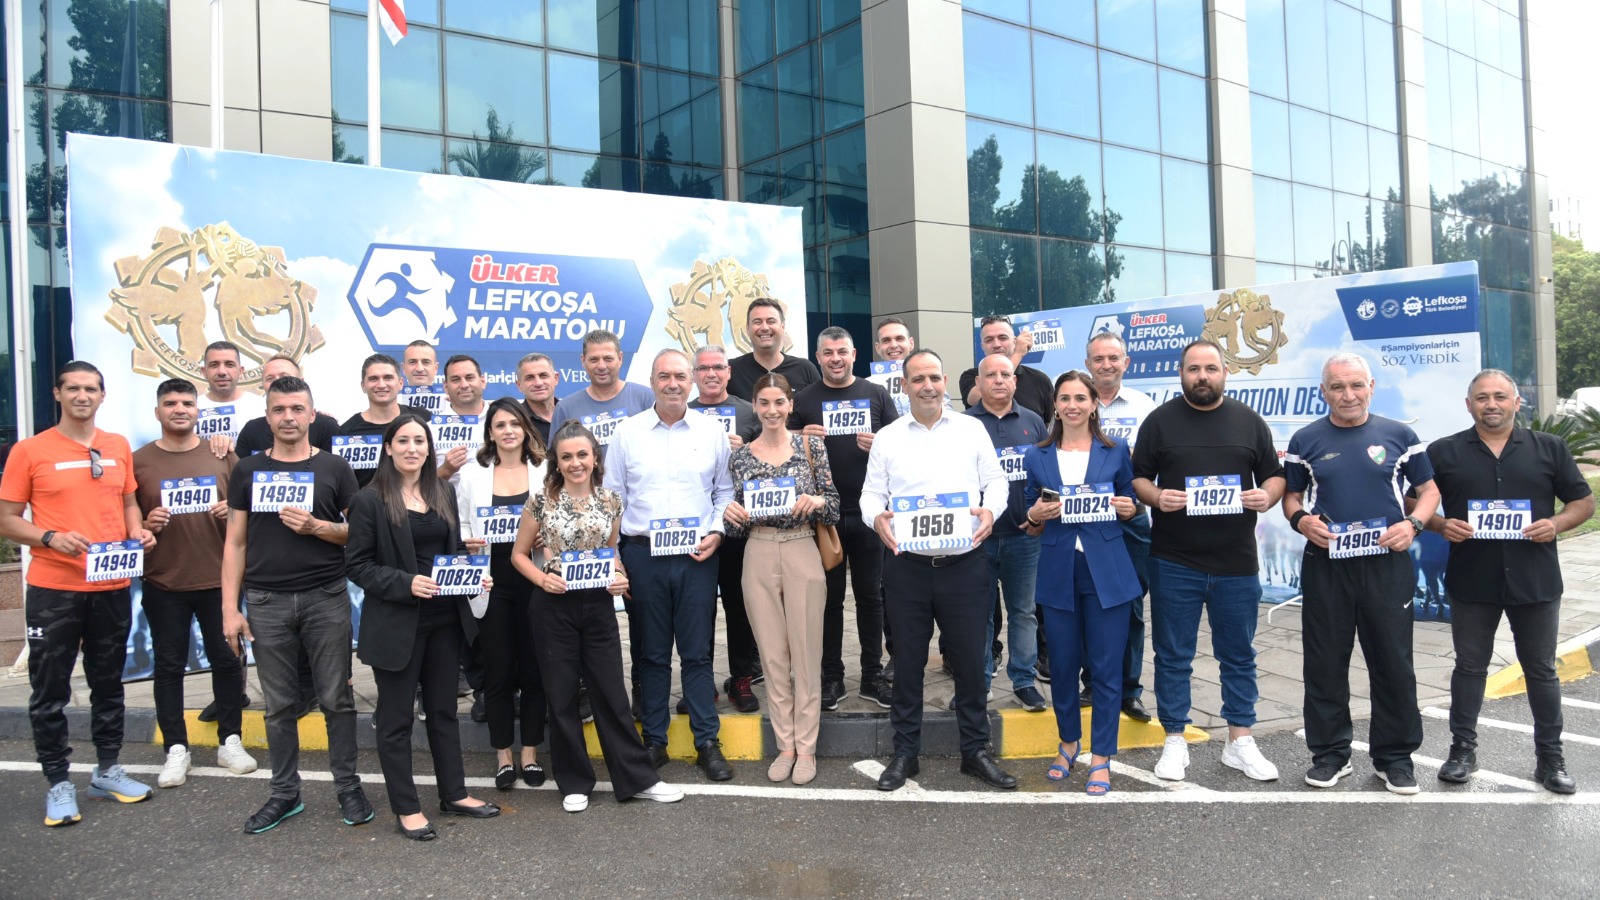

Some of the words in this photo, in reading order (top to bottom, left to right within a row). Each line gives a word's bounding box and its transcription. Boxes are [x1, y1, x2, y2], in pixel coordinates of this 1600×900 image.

[471, 256, 558, 284] ÜLKER
[468, 289, 598, 318] LEFKOŞA
[1425, 295, 1467, 306] Lefkoşa
[464, 316, 625, 340] MARATONU
[1130, 313, 1167, 327] ÜLKER
[1033, 330, 1058, 345] 3061
[1129, 324, 1184, 340] LEFKOŞA
[1382, 355, 1407, 367] SÖZ
[1410, 350, 1461, 365] VERDİK
[560, 368, 591, 383] VER
[886, 376, 904, 395] 19
[408, 395, 441, 409] 14901
[1293, 386, 1331, 416] DES
[196, 416, 231, 435] 14913
[589, 418, 624, 439] 1493
[828, 411, 866, 428] 14925
[438, 426, 473, 441] 14941
[338, 446, 378, 462] 14936
[167, 488, 211, 507] 14940
[260, 485, 307, 503] 14939
[750, 490, 790, 509] 14937
[1193, 488, 1236, 507] 14927
[1064, 496, 1110, 515] 00824
[911, 512, 955, 538] 1958
[1477, 513, 1523, 530] 14910
[654, 530, 697, 548] 00829
[1336, 531, 1382, 551] 14909
[93, 552, 139, 573] 14948
[566, 561, 611, 582] 00324
[435, 568, 483, 586] 00826
